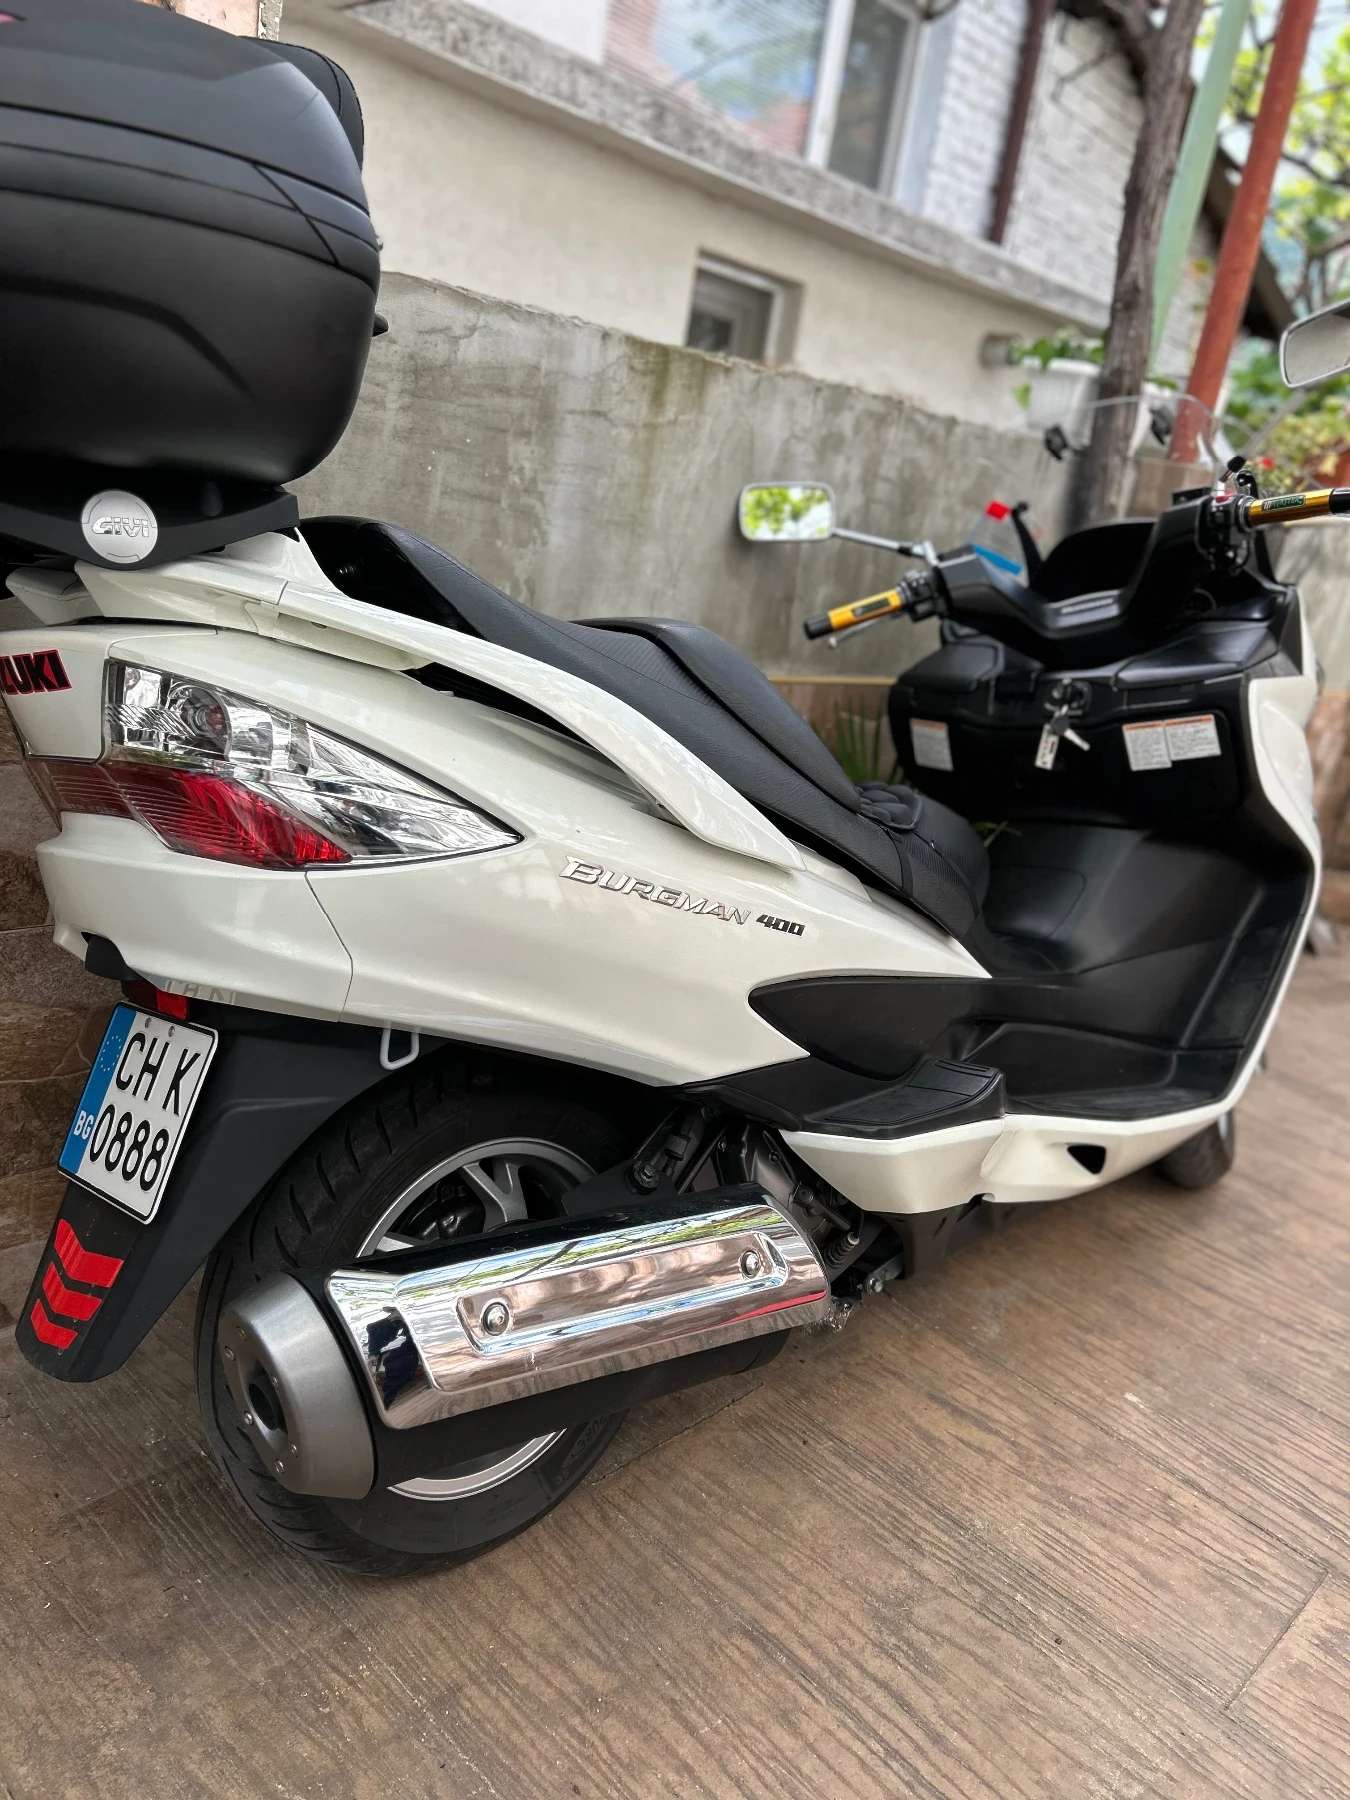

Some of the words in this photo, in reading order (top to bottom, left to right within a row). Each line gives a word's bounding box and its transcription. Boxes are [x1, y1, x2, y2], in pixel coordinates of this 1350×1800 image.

[92, 516, 150, 538] GIVI
[559, 855, 751, 925] BURGMAN
[755, 914, 806, 937] 400
[115, 1032, 170, 1102] CH
[162, 1048, 201, 1116] K
[73, 1109, 94, 1140] BG
[89, 1104, 170, 1192] 0888
